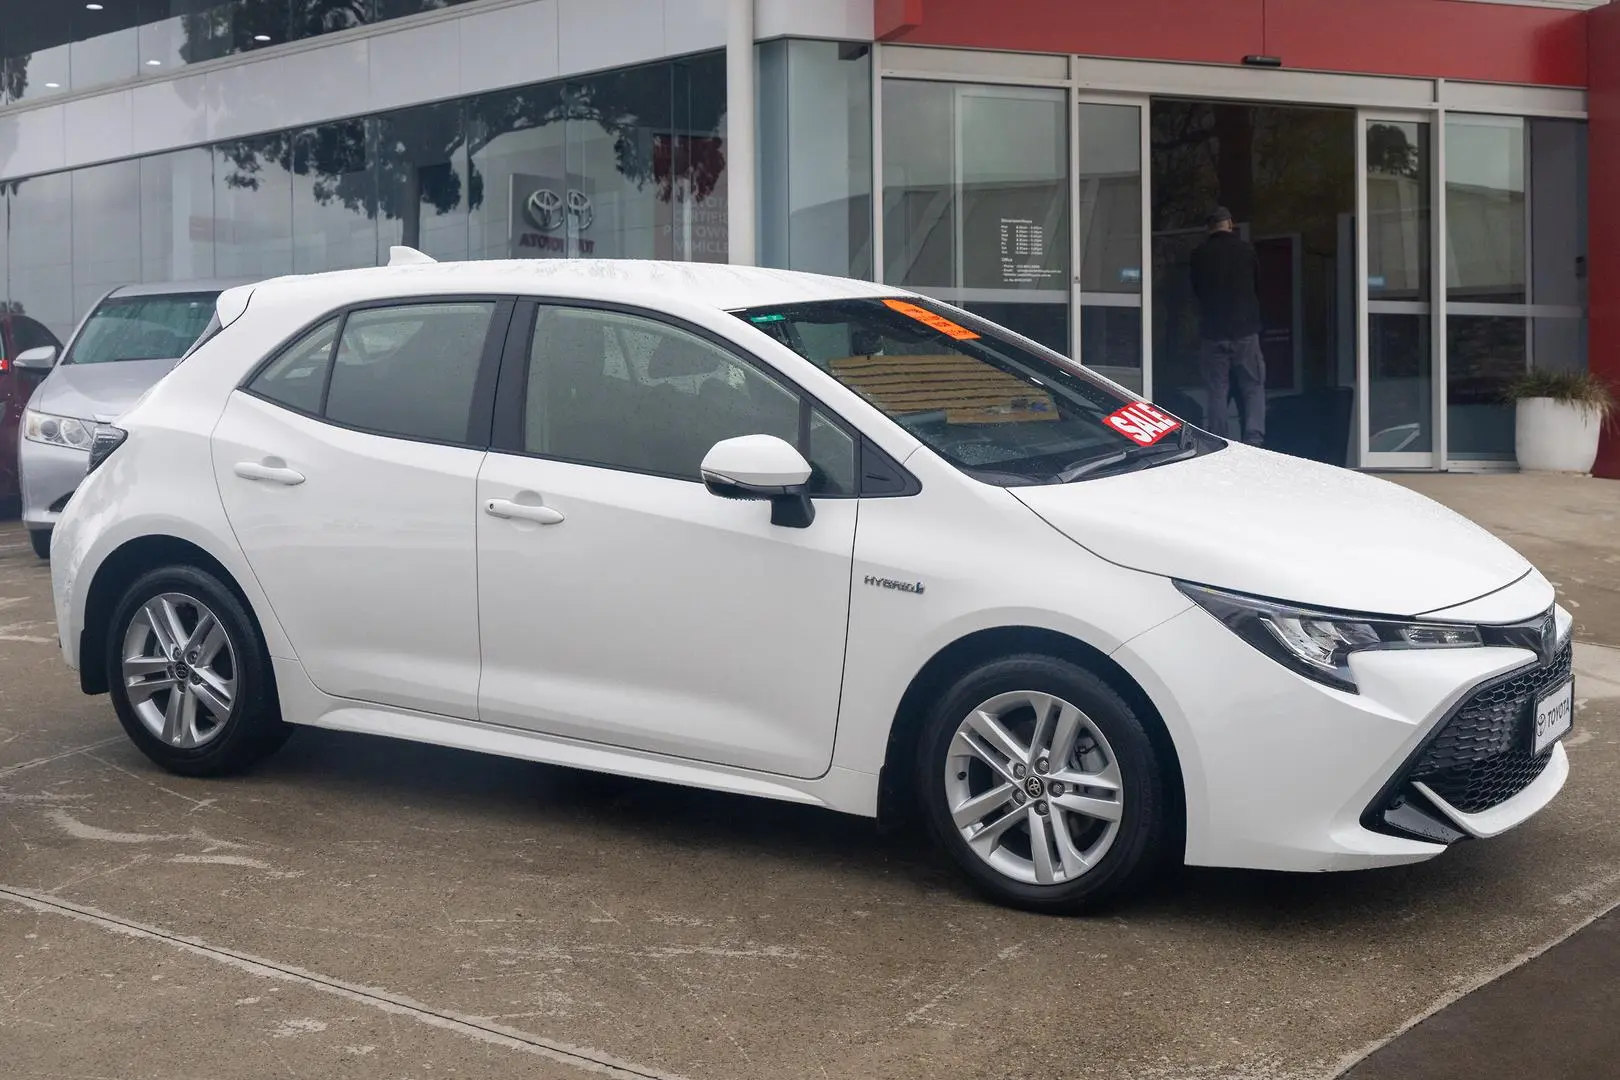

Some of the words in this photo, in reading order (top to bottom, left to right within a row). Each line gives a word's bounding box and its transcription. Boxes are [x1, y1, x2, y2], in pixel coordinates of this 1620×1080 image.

[1110, 402, 1177, 443] SALE
[864, 575, 915, 592] HYBRID
[1547, 697, 1570, 728] TOYOTA
